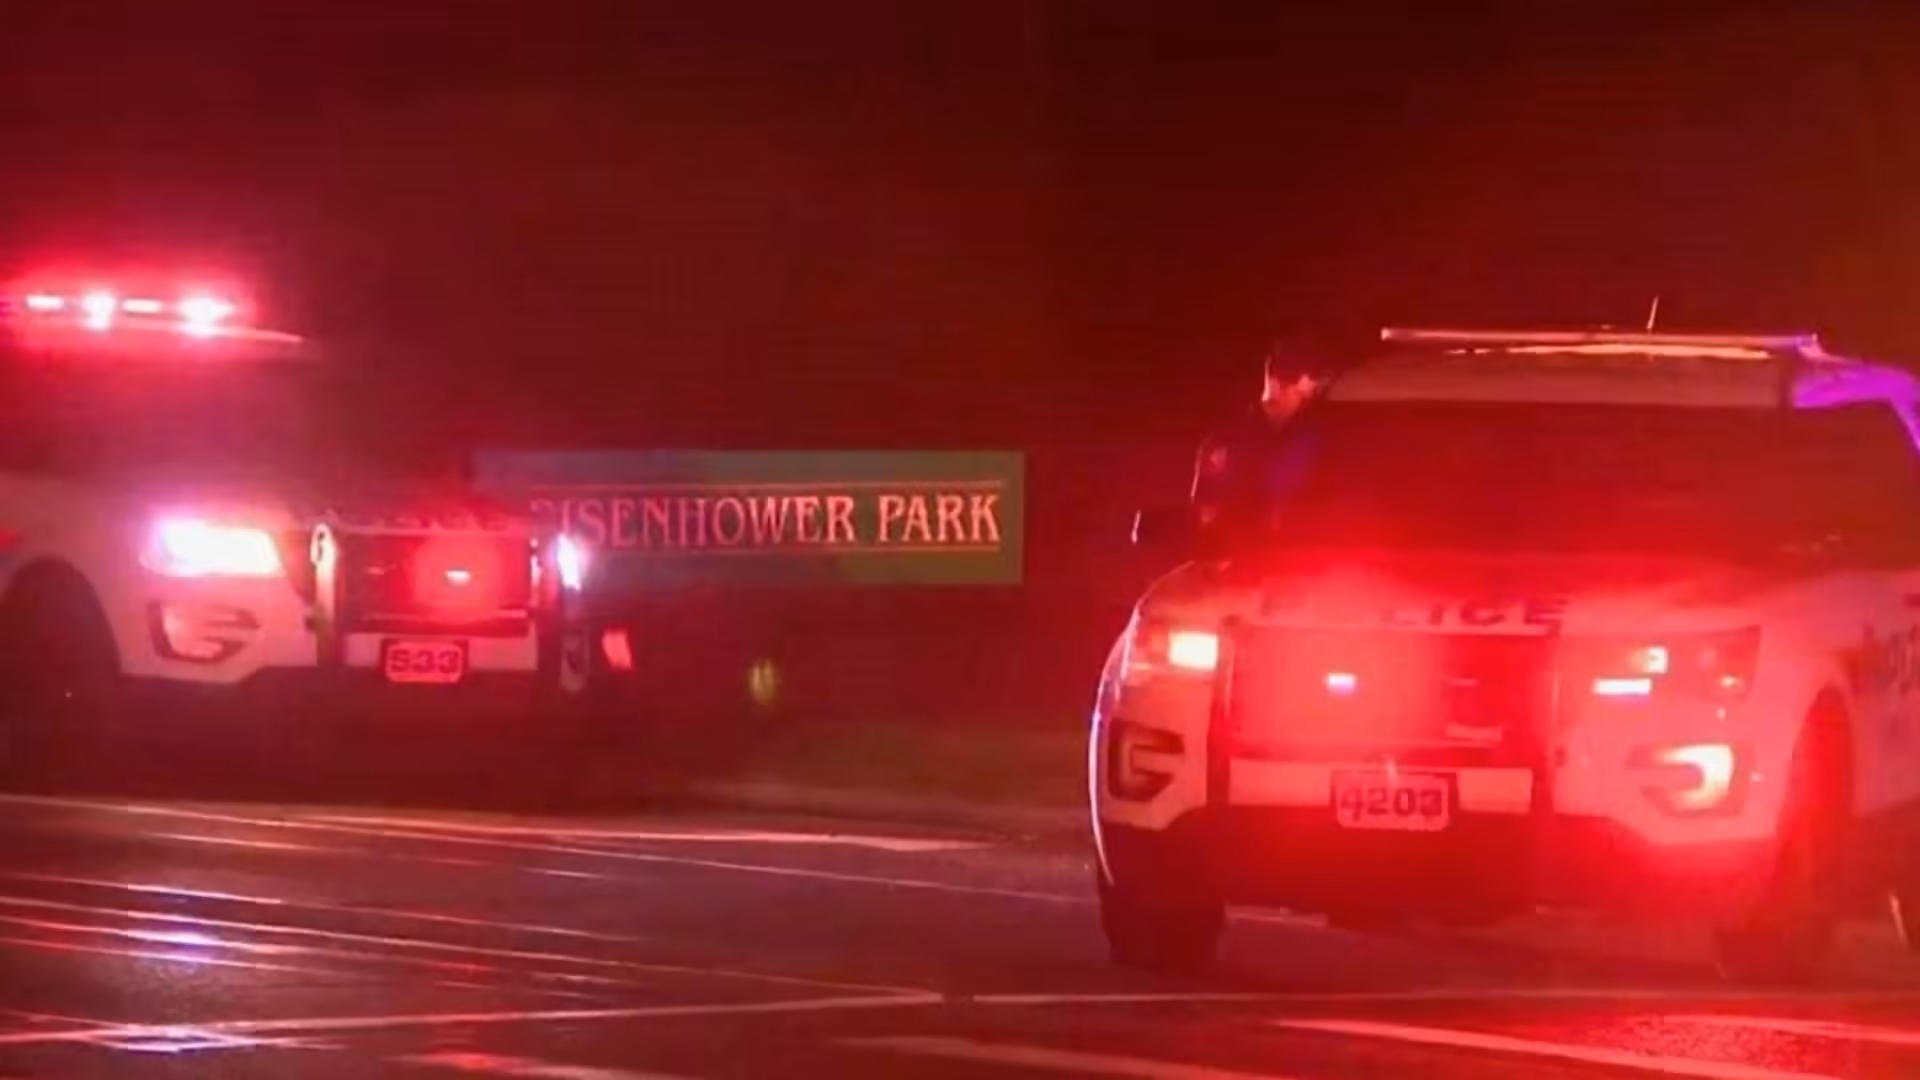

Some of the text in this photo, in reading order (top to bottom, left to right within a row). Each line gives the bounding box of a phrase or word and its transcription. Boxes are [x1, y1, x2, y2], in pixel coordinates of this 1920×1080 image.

[878, 494, 1001, 542] PARK
[1260, 594, 1568, 626] PLICE
[1340, 787, 1443, 822] 4203
